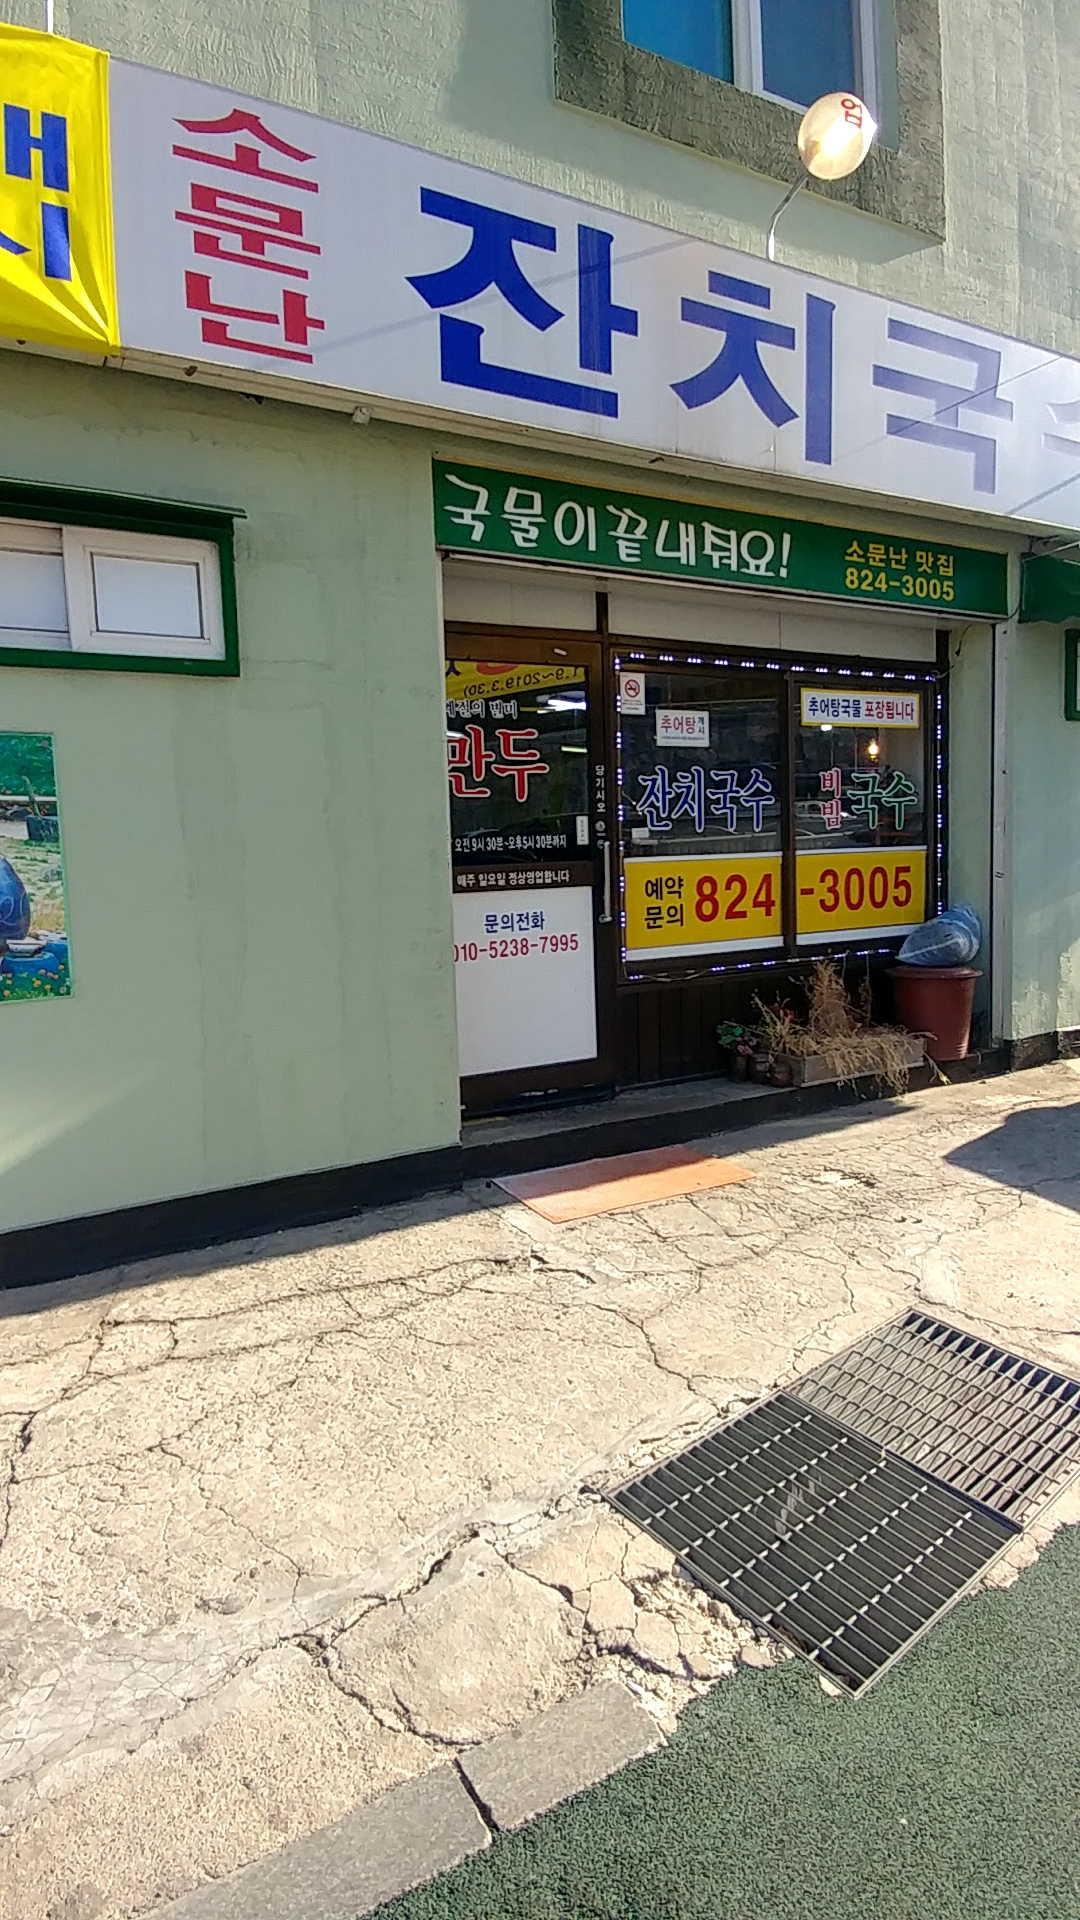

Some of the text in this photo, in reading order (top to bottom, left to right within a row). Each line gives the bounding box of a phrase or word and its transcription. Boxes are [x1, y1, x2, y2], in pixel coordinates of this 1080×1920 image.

[172, 108, 325, 364] 소문난
[443, 473, 596, 552] 국물이
[844, 540, 954, 577] 소문난 맛집
[845, 567, 955, 602] 824-3005
[489, 699, 518, 720] 별미
[660, 714, 697, 735] 추어탕
[808, 696, 916, 721] 추어탕국물 포장됩니다
[447, 723, 550, 803] 만두
[594, 764, 607, 813] 당기시오
[636, 765, 775, 833] 잔치국수
[818, 766, 919, 830] 비빔 국수
[454, 838, 471, 853] 오전
[471, 837, 486, 852] 9시
[535, 833, 567, 849] 30분까지
[456, 869, 571, 888] 매주 일요일 정상영업합니다
[644, 876, 684, 900] 예약
[695, 873, 775, 922] 824
[484, 911, 545, 933] 문의전화
[644, 903, 685, 930] 문의
